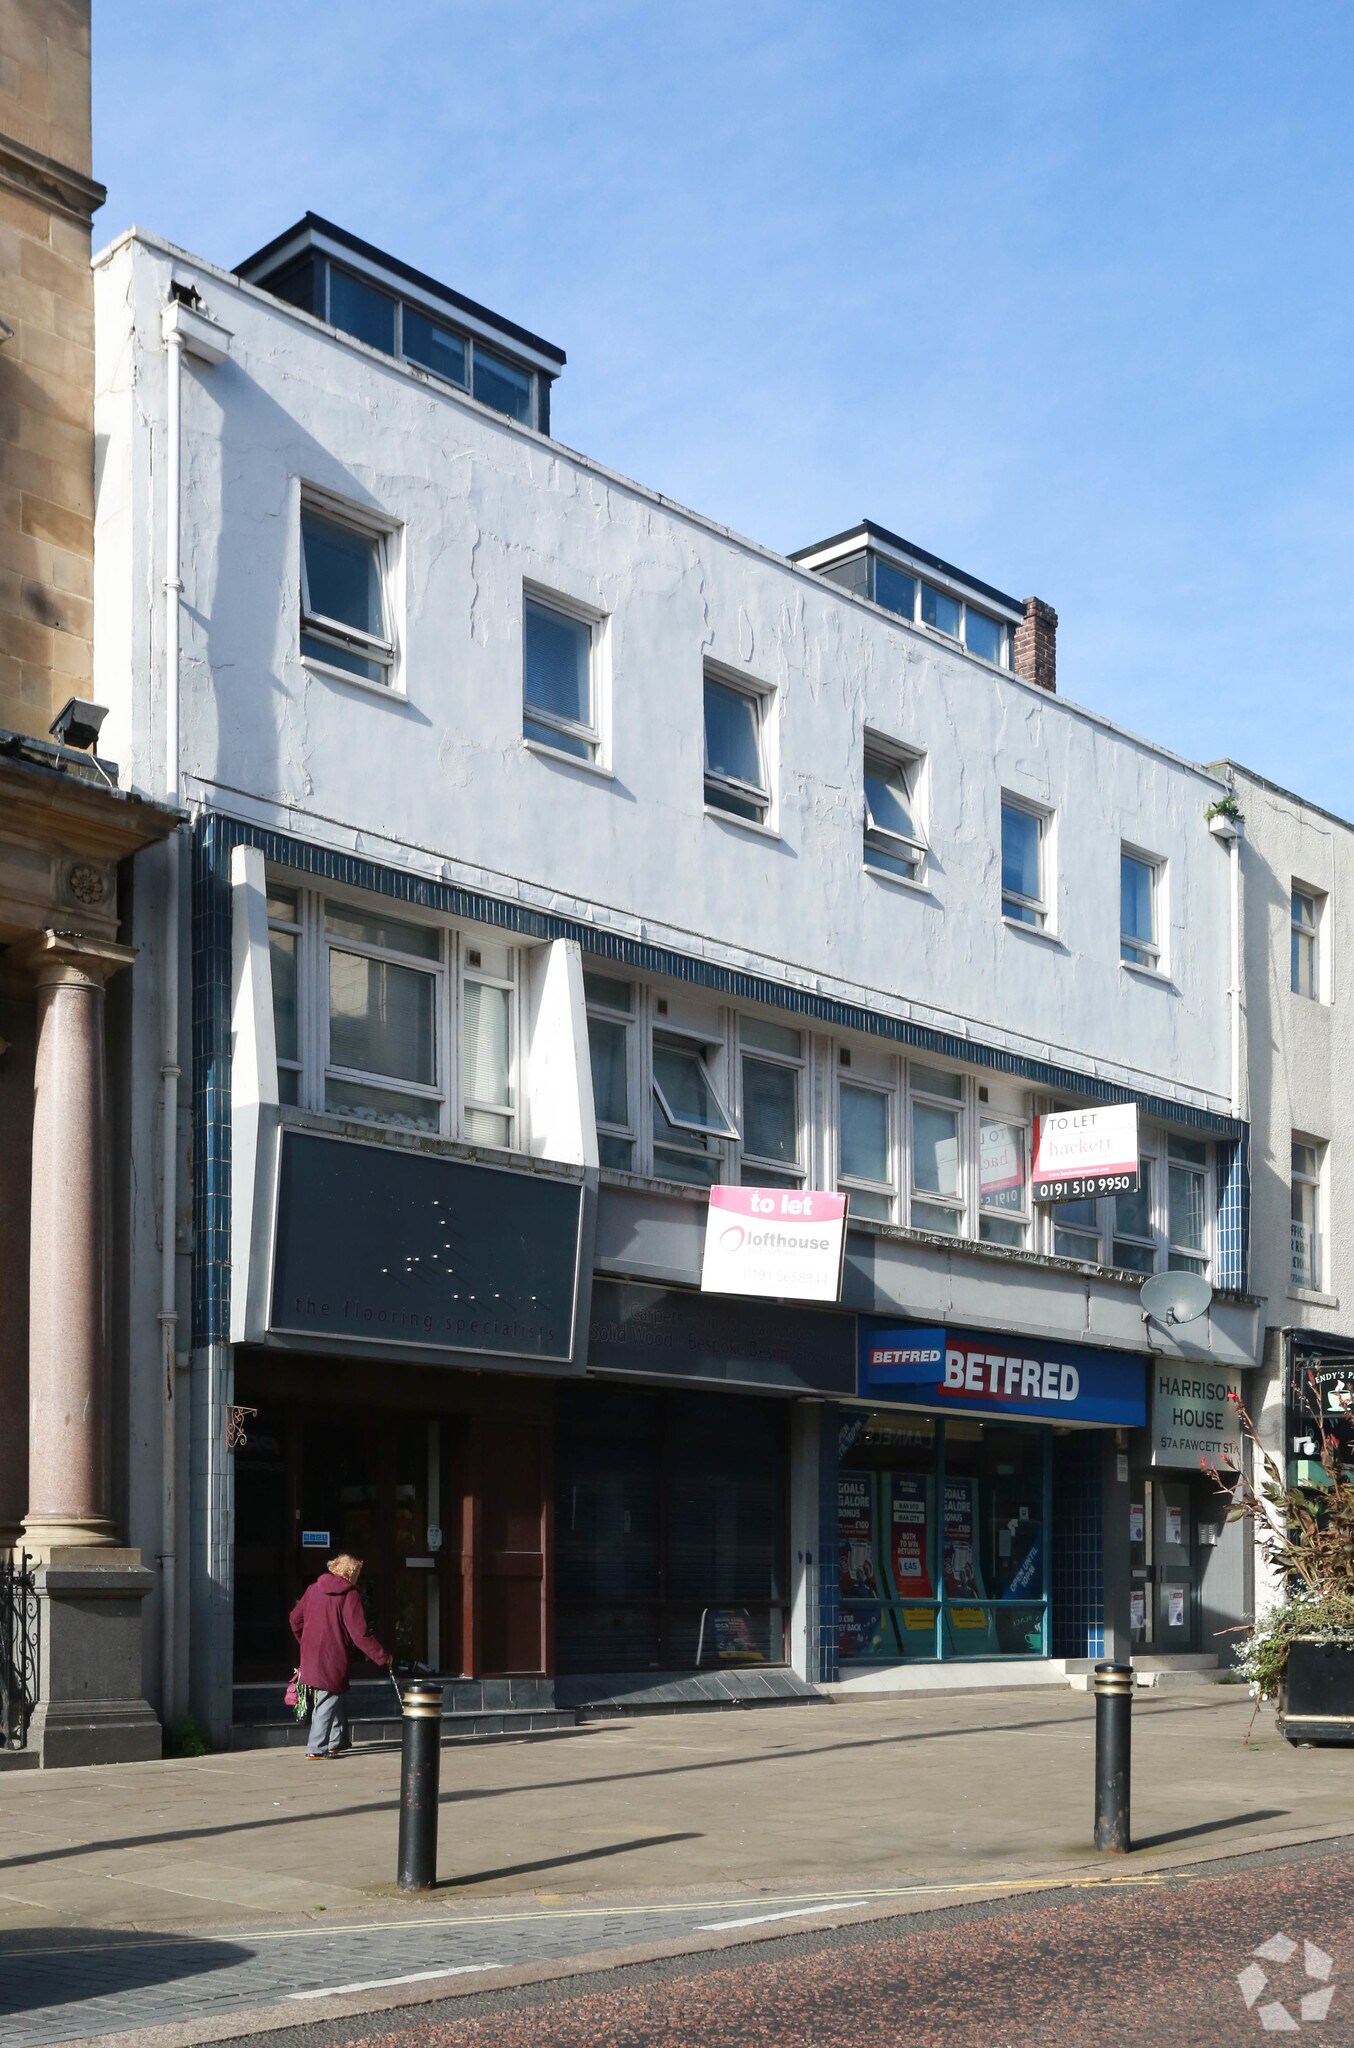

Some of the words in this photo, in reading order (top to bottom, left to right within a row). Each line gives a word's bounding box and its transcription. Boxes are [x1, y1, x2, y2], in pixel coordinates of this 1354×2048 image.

[1049, 1118, 1068, 1130] TO
[1074, 1114, 1098, 1128] LET
[1050, 1137, 1112, 1157] hackett
[1040, 1182, 1068, 1197] 0191
[1073, 1180, 1095, 1194] 510
[1098, 1176, 1130, 1191] 9950
[750, 1192, 775, 1214] to
[781, 1194, 813, 1216] let
[747, 1231, 830, 1250] lofthouse
[295, 1297, 330, 1317] the
[343, 1302, 434, 1333] flooring
[445, 1317, 555, 1342] specialists
[630, 1301, 684, 1328] Carpets
[590, 1321, 627, 1343] Solid
[631, 1325, 673, 1347] Wood
[688, 1332, 744, 1356] Bespoke
[873, 1350, 941, 1364] BETFRED
[944, 1349, 1080, 1401] BETFRED
[1314, 1371, 1345, 1384] ENDY'S
[1159, 1376, 1237, 1402] HARRISON
[1173, 1408, 1224, 1430] HOUSE
[1160, 1436, 1178, 1449] 57A
[1180, 1439, 1221, 1452] FAWCETT
[838, 1495, 870, 1508] GALORE
[902, 1532, 916, 1540] BOTH
[908, 1540, 918, 1548] WIN
[904, 1562, 917, 1571] £45
[1010, 1568, 1024, 1592] OPEN
[1022, 1546, 1038, 1570] UNTIL
[1021, 1564, 1036, 1587] 10PM
